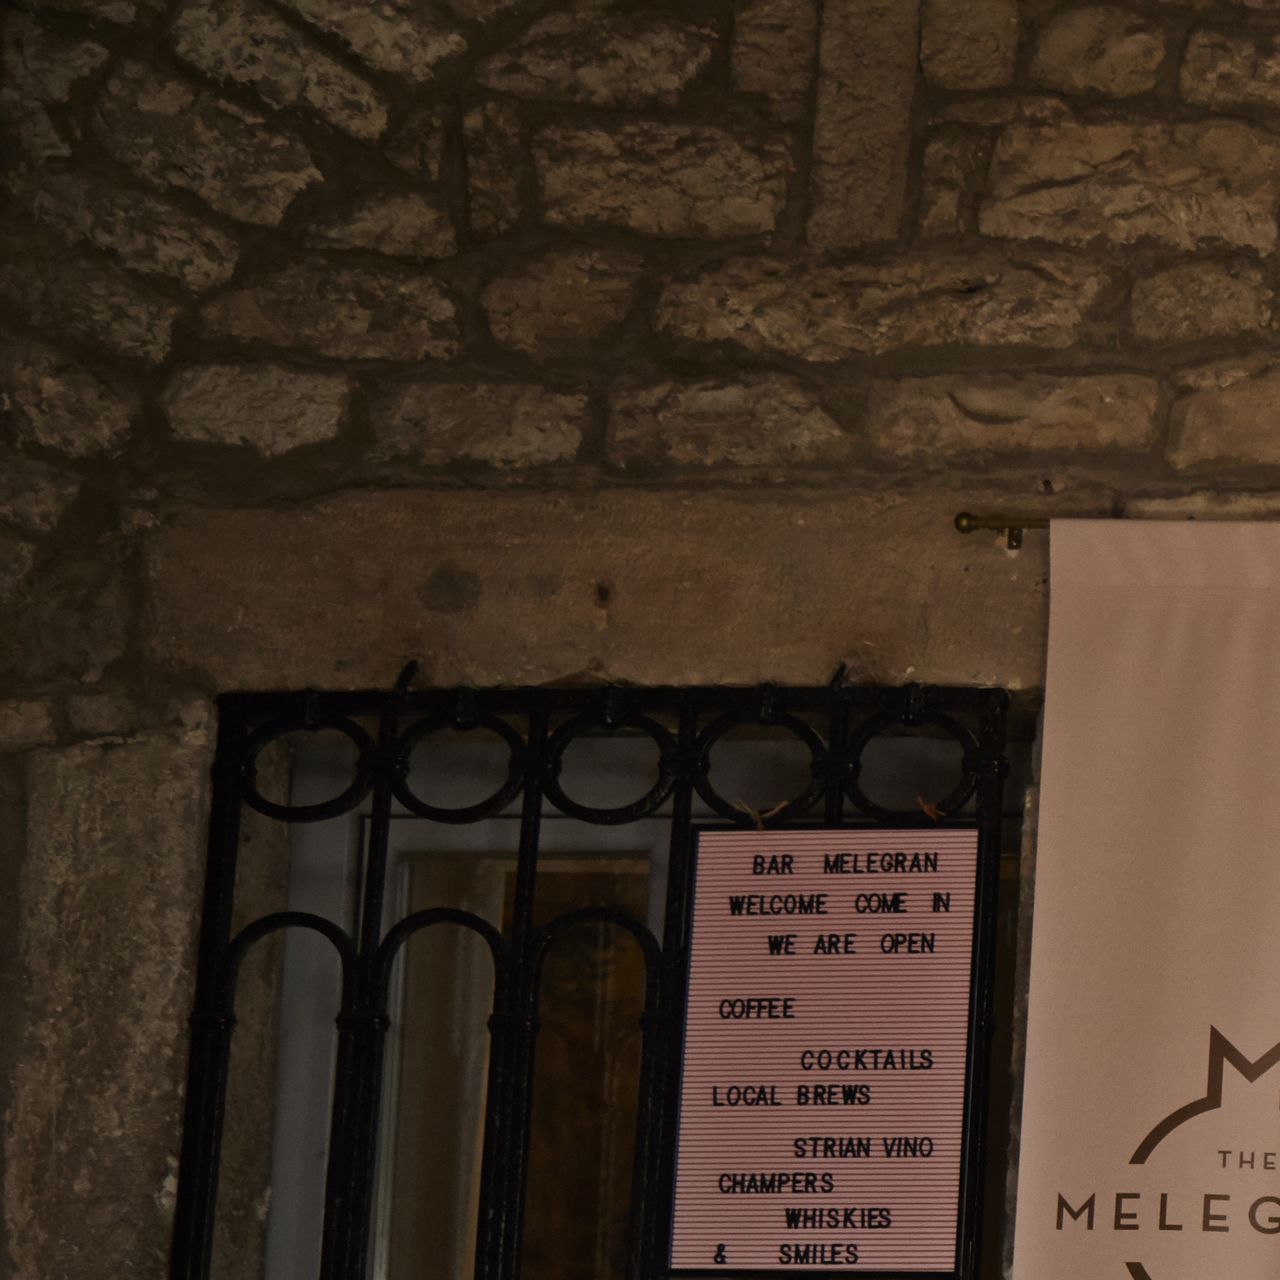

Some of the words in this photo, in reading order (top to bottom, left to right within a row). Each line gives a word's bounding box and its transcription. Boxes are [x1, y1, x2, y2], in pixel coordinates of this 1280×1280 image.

[752, 854, 794, 875] BAR
[824, 852, 938, 873] MELEGRAN
[729, 895, 828, 915] WELCOME
[855, 894, 908, 914] COME
[933, 893, 950, 912] IN
[768, 934, 797, 955] WE
[814, 934, 856, 954] ARE
[881, 934, 935, 953] OPEN
[719, 998, 795, 1019] COFFEE
[801, 1050, 933, 1070] COCKTAILS
[713, 1086, 781, 1107] LOCAL
[797, 1085, 871, 1105] BREWS
[794, 1138, 870, 1158] STRIAN
[884, 1138, 933, 1157] VINO
[1218, 1150, 1277, 1170] THE
[719, 1173, 834, 1193] CHAMPERS
[785, 1208, 891, 1229] WHISKIES
[714, 1244, 726, 1264] &
[779, 1244, 858, 1264] SMILES
